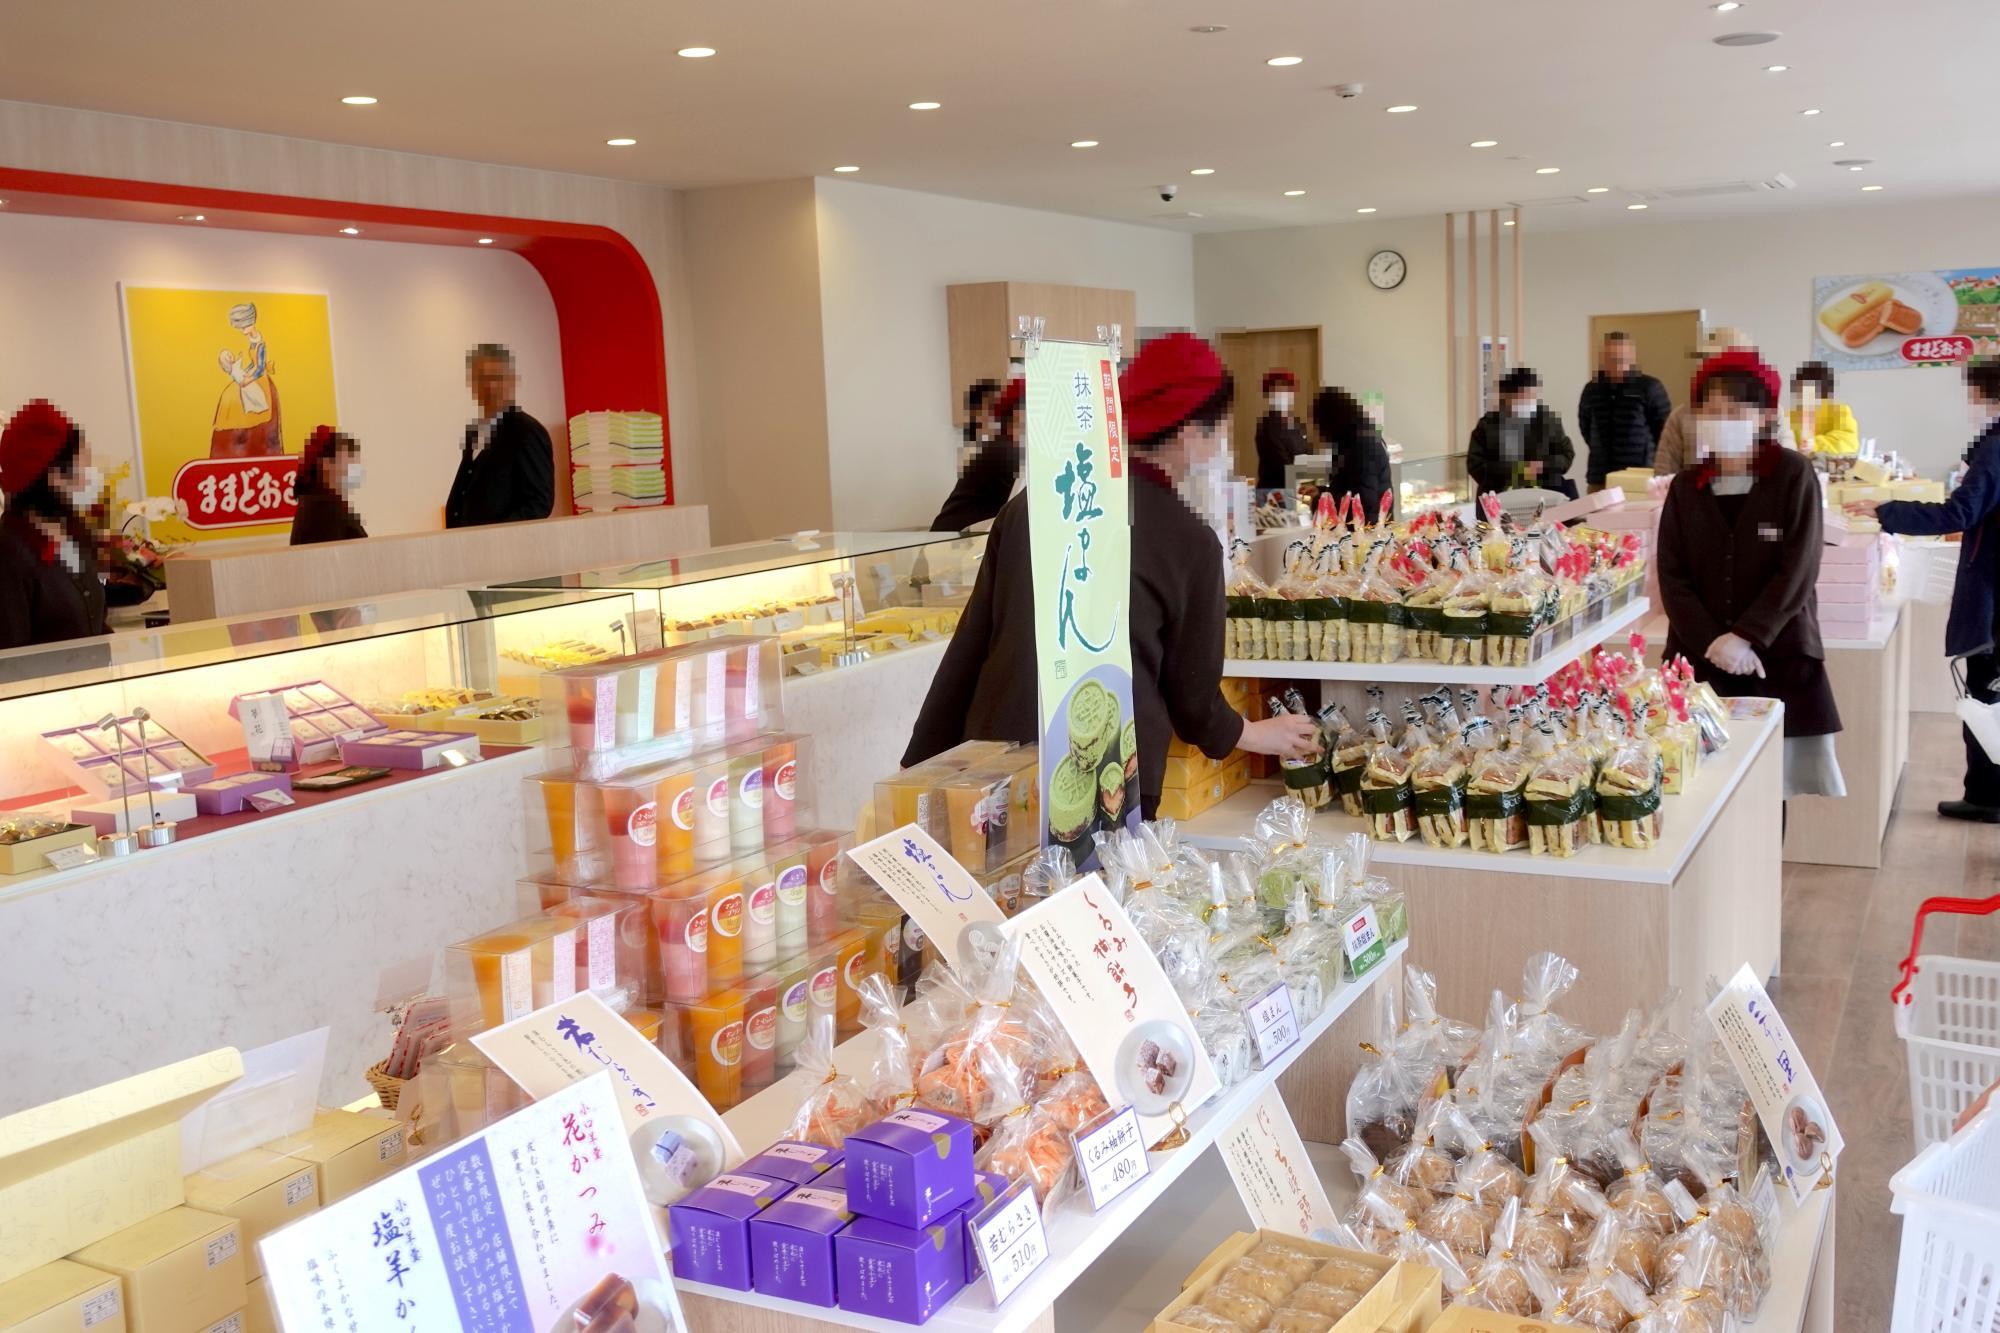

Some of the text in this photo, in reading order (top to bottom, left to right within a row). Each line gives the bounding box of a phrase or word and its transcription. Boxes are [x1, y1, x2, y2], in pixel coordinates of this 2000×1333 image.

[1073, 371, 1094, 431] 抹茶
[1102, 372, 1120, 464] 期間限定
[1262, 1002, 1282, 1024] 塩まん
[1088, 1121, 1135, 1164] くるみ柚餅子
[562, 1112, 606, 1234] 花かつみ
[1111, 1157, 1138, 1184] 480円
[988, 1204, 1032, 1255] 若むらさき
[1010, 1240, 1038, 1274] 510円
